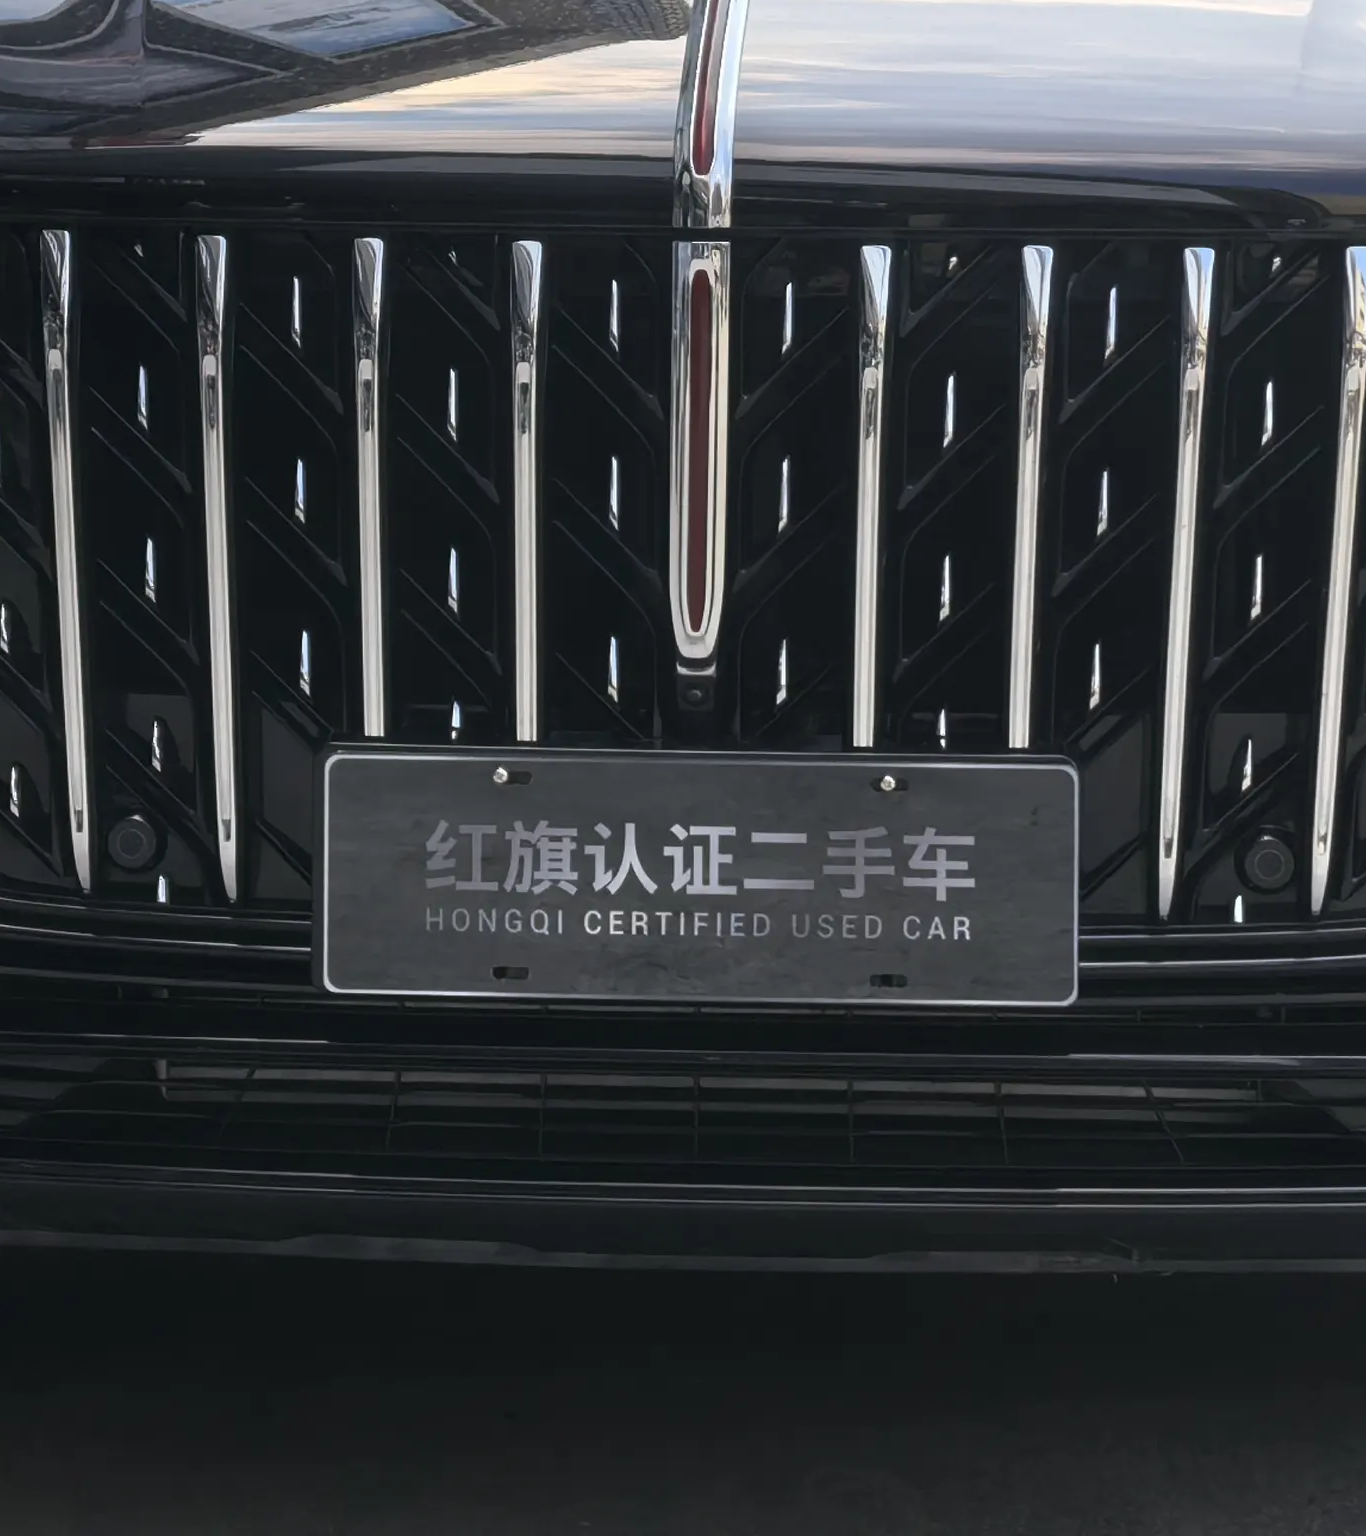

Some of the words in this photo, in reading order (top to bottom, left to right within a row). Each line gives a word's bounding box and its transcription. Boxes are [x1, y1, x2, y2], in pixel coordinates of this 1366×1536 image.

[424, 818, 978, 903] 红旗认证二手车
[425, 905, 564, 937] HONGQI
[583, 908, 771, 938] CERTIFIED
[791, 914, 883, 940] USED
[902, 915, 973, 942] CAR
